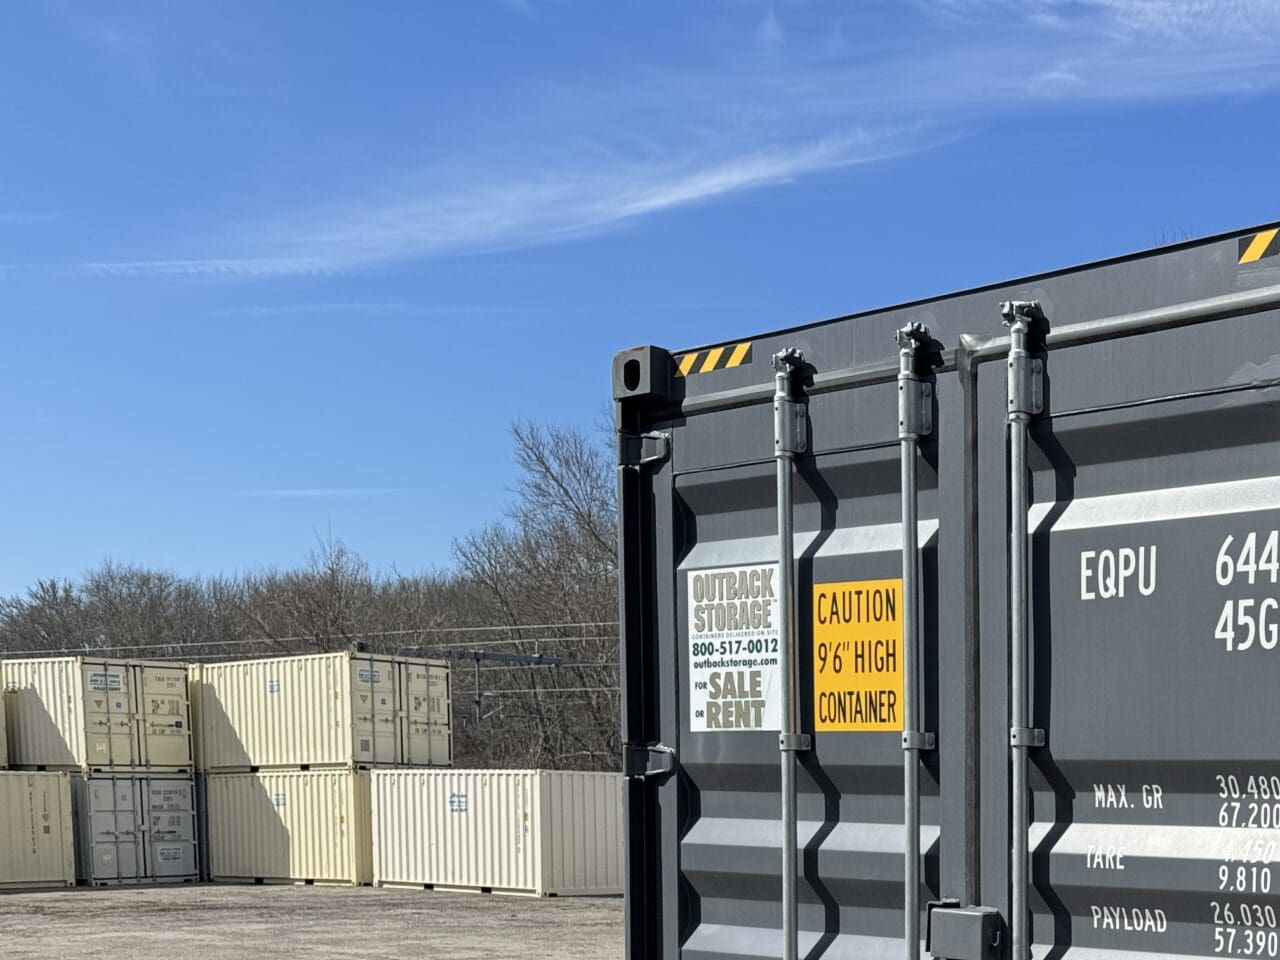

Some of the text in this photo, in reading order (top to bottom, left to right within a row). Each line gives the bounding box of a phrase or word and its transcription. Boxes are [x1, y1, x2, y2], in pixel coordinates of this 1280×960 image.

[692, 567, 775, 603] OUTBACK
[1080, 545, 1157, 600] EQPU
[693, 599, 772, 633] STORAGE
[817, 588, 897, 625] CAUTION
[692, 638, 779, 657] 800-517-0012
[726, 630, 755, 639] DELIVERED
[693, 657, 778, 669] outbackstorage.com
[854, 639, 897, 673] HIGH
[694, 670, 763, 701] FOR SALE
[695, 700, 766, 729] OR RENT
[818, 690, 897, 724] CONTAINER
[1093, 784, 1164, 810] MAX. GR
[1086, 844, 1126, 870] TARE
[1218, 864, 1271, 894] 9,810
[1091, 905, 1168, 932] PAYLOAD
[1214, 927, 1278, 957] 57,390
